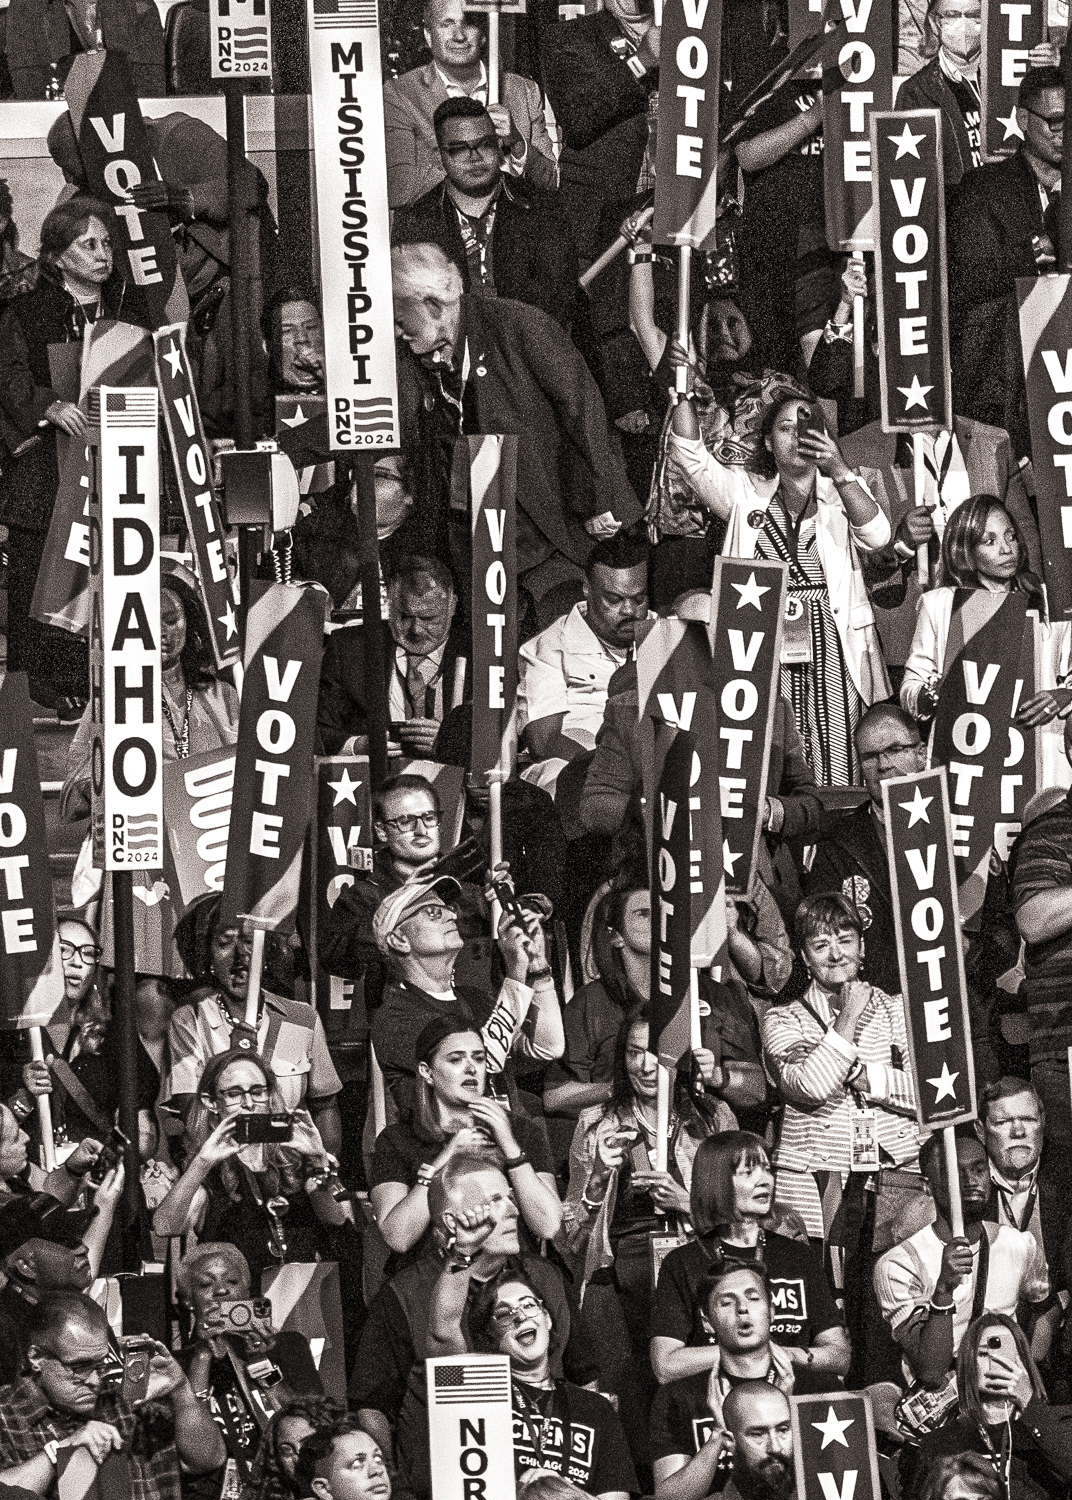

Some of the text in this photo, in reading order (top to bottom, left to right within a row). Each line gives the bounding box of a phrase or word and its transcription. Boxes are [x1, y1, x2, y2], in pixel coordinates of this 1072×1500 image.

[675, 0, 706, 178] VOTE
[837, 0, 874, 182] VOTE
[89, 112, 163, 287] VOTE
[331, 42, 373, 385] MISSISSIPPI
[891, 178, 929, 356] VOTE
[111, 445, 157, 798] IDAHO
[484, 509, 507, 709] VOTE
[249, 656, 302, 859] VOTE
[718, 629, 766, 818] VOTE
[904, 844, 952, 1042] VOTE
